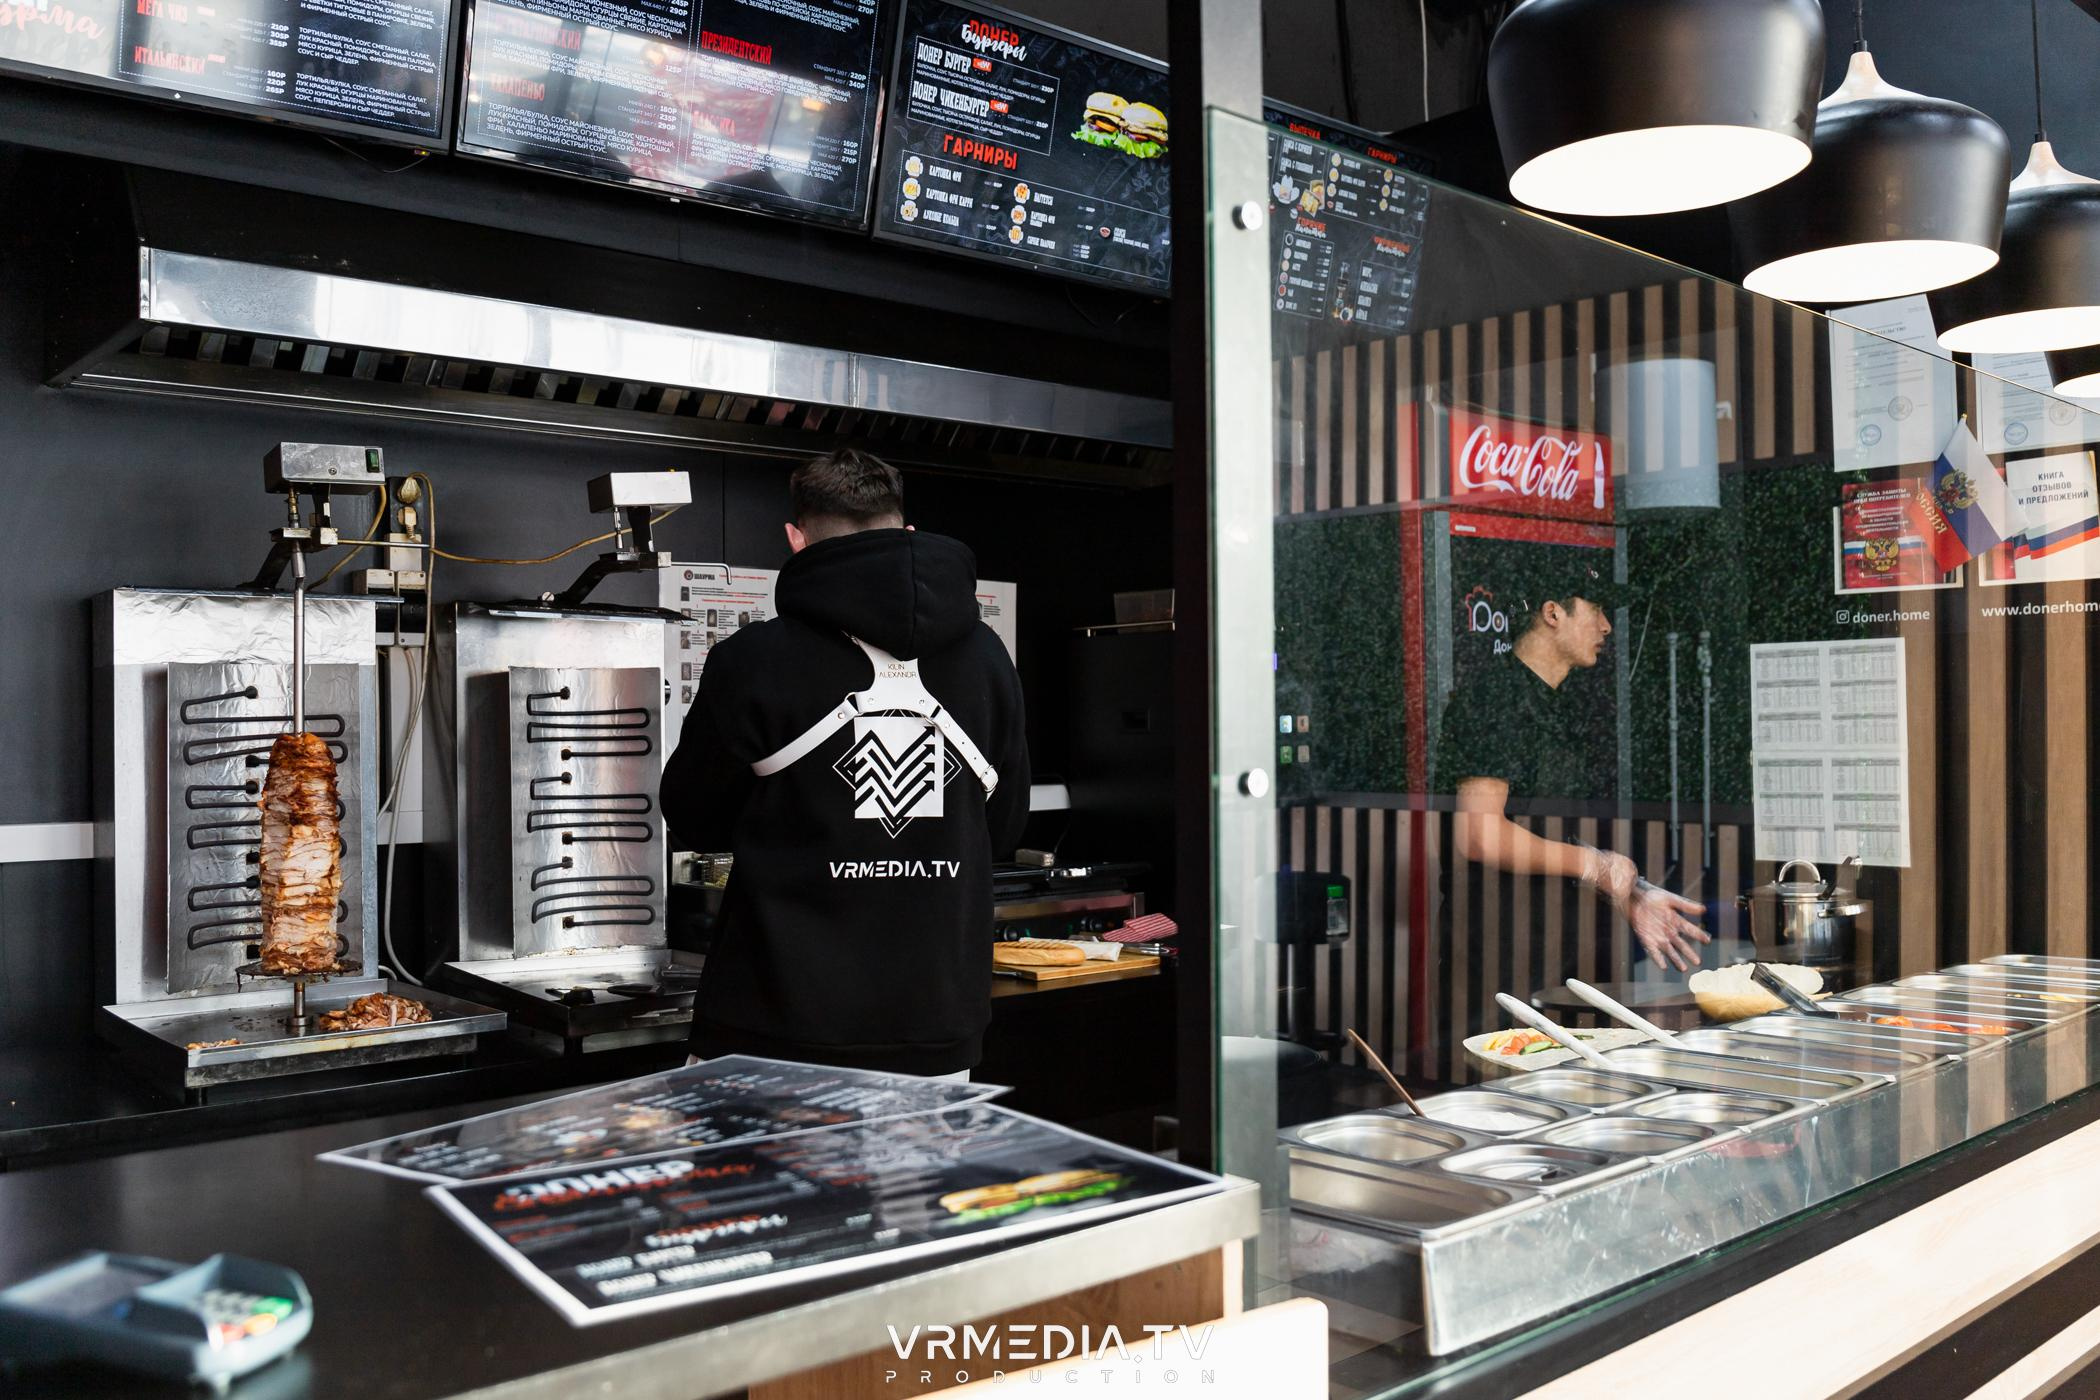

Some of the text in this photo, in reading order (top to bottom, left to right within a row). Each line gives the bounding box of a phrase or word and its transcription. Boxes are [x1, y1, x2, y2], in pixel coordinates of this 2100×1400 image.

[306, 3, 373, 23] ФИРМЕННЫЙ ОСТРЫЙ
[385, 7, 409, 18] ОГУРЦЫ
[527, 3, 600, 27] ФИРМЕННЫЙ ОСТРЫЙ
[629, 8, 645, 18] СОУС
[669, 6, 687, 16] 290Р
[748, 0, 830, 28] ЗЕЛЕНЬ ФИРМЕННЫЙ ОСТРЫЙ
[808, 4, 821, 13] СОУС
[858, 4, 873, 15] 270Р
[270, 22, 288, 32] 210Р
[591, 5, 618, 17] ОГУРЦЫ
[647, 20, 682, 34] КАРТОШКА
[627, 21, 645, 31] МЯСО
[298, 33, 310, 42] ЛУК
[382, 51, 405, 62] СЫРНАЯ
[355, 38, 370, 47] СОУС
[701, 31, 772, 65] ПРЕЗИДЕНТСКИЙ
[961, 24, 1027, 62] Бургеры
[297, 47, 314, 56] СОУС
[320, 52, 333, 60] СЫР
[298, 40, 316, 50] МЯСО
[317, 44, 342, 55] КУРИЦА,
[369, 55, 407, 69] ФИРМЕННЫЙ
[408, 63, 433, 74] ОСТРЫЙ
[917, 41, 970, 74] ДОНЕР БУРГЕР
[267, 77, 285, 87] 220Р
[850, 71, 866, 81] 220Р
[296, 78, 308, 87] ЛУК
[341, 88, 365, 99] ОГУРЦЫ
[352, 83, 367, 93] СОУС
[848, 80, 865, 90] 340Р
[295, 85, 313, 95] МЯСО
[314, 89, 340, 100] КУРИЦА,
[366, 100, 405, 113] ФИРМЕННЫЙ
[406, 108, 430, 118] ОСТРЫЙ
[313, 96, 350, 109] ПЕППЕРОНИ
[357, 105, 370, 113] СЫР
[913, 80, 989, 118] ДОНЕР ЧИКЕНБУРГЕР
[488, 101, 549, 121] ТОРТИЛЬЯ/БУЛКА,
[550, 115, 568, 126] СОУС
[569, 119, 616, 136] МАЙОНЕЗНЫЙ,
[617, 130, 633, 140] СОУС
[487, 108, 502, 118] ЛУК
[503, 111, 536, 125] КРАСНЫЙ,
[537, 119, 578, 134] ПОМИДОРЫ,
[580, 128, 606, 141] ОГУРЦЫ
[636, 140, 670, 155] КАРТОШКА
[506, 119, 547, 134] ХАЛАПЕНЬО
[549, 128, 605, 147] МАРИНОВАННЫЕ,
[607, 141, 625, 151] МЯСО
[515, 128, 559, 144] ФИРМЕННЫЙ
[561, 138, 588, 150] ОСТРЫЙ
[841, 155, 856, 165] 270Р
[943, 133, 1017, 171] ГАРНИРЫ
[1459, 425, 1583, 501] Coca-Cola
[2038, 471, 2064, 480] КНИГА
[2032, 481, 2072, 493] ОТЗЫВОВ
[2026, 488, 2089, 504] ПРЕДЛОЖЕНИЙ
[1853, 609, 1930, 624] doner.home
[829, 860, 960, 878] VRMEDIA.TV
